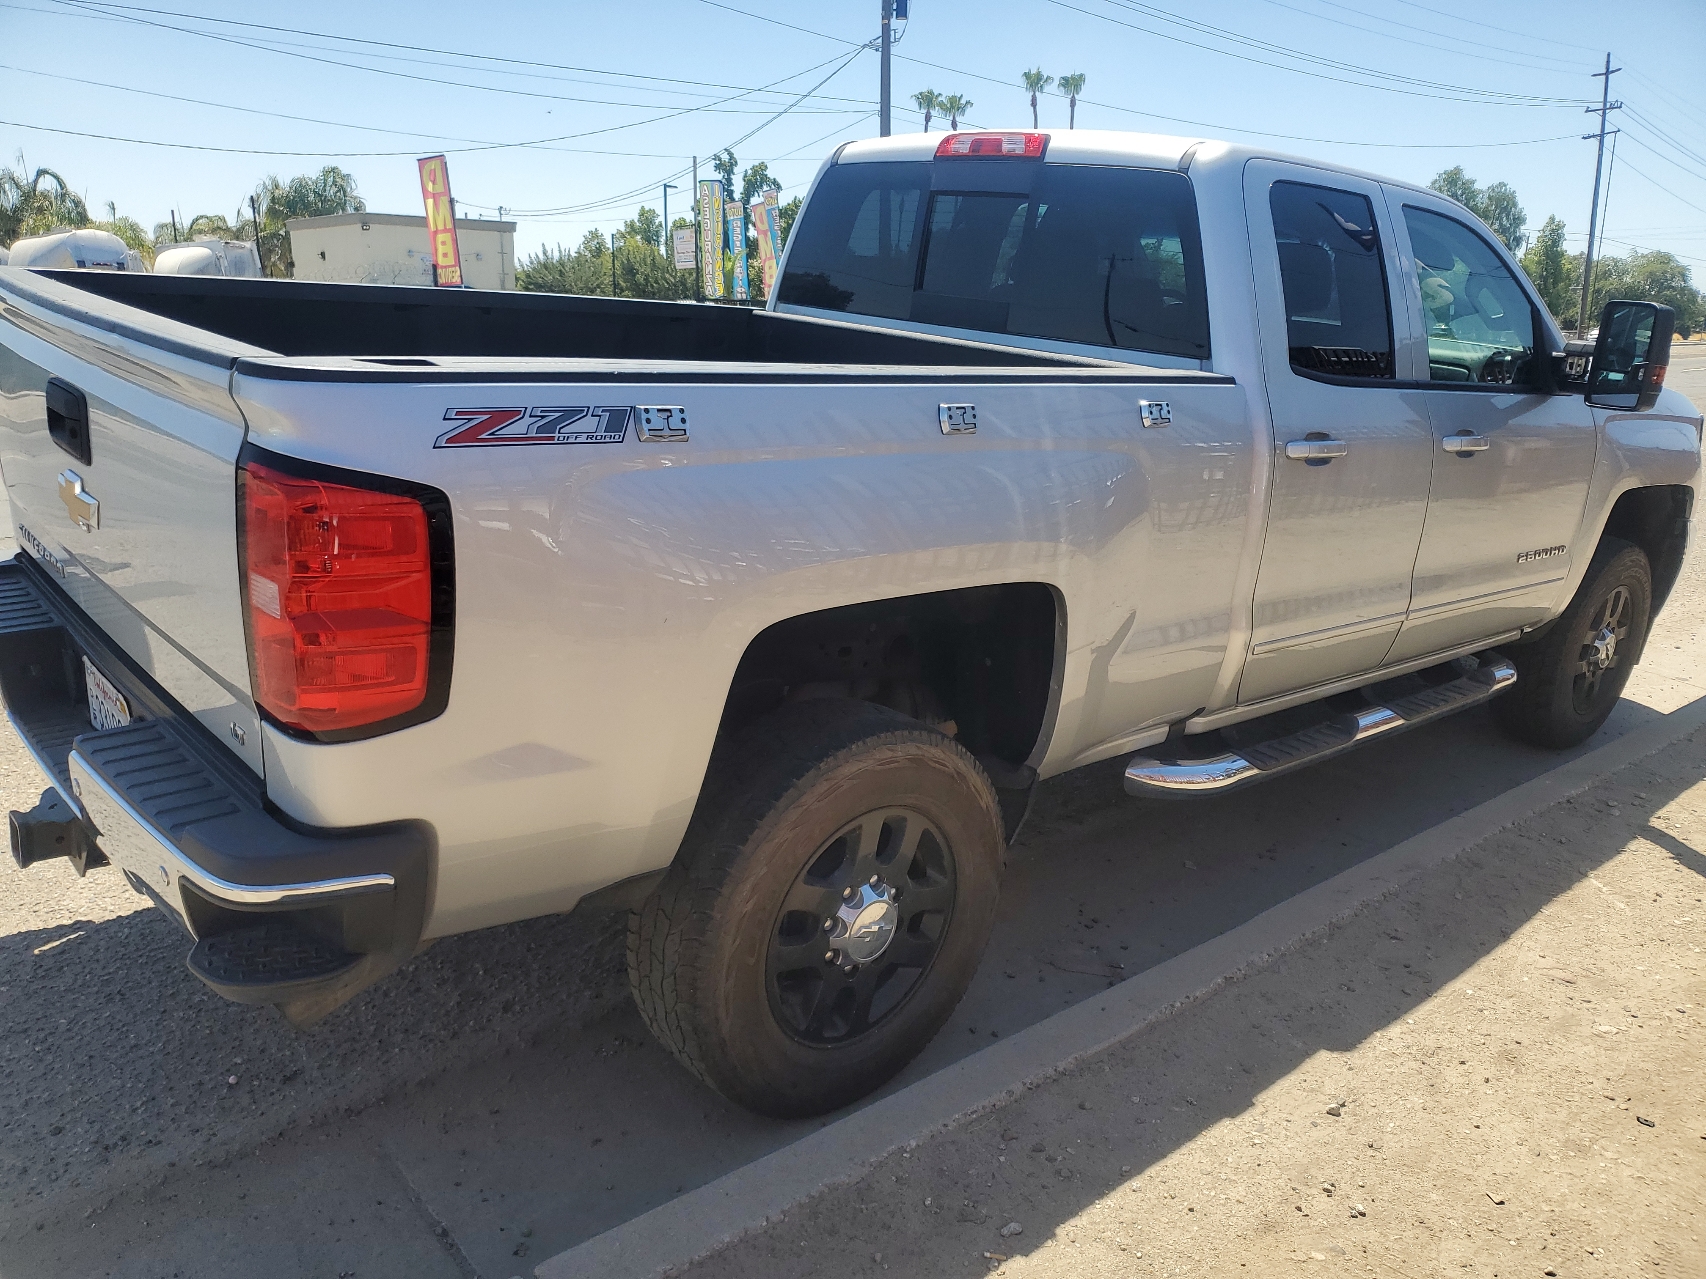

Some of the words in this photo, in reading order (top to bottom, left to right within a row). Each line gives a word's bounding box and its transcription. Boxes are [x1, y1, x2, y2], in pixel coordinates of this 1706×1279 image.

[433, 406, 633, 449] Z71
[556, 434, 583, 442] OFF
[585, 433, 622, 441] ROAD
[1516, 544, 1567, 564] 2500HD
